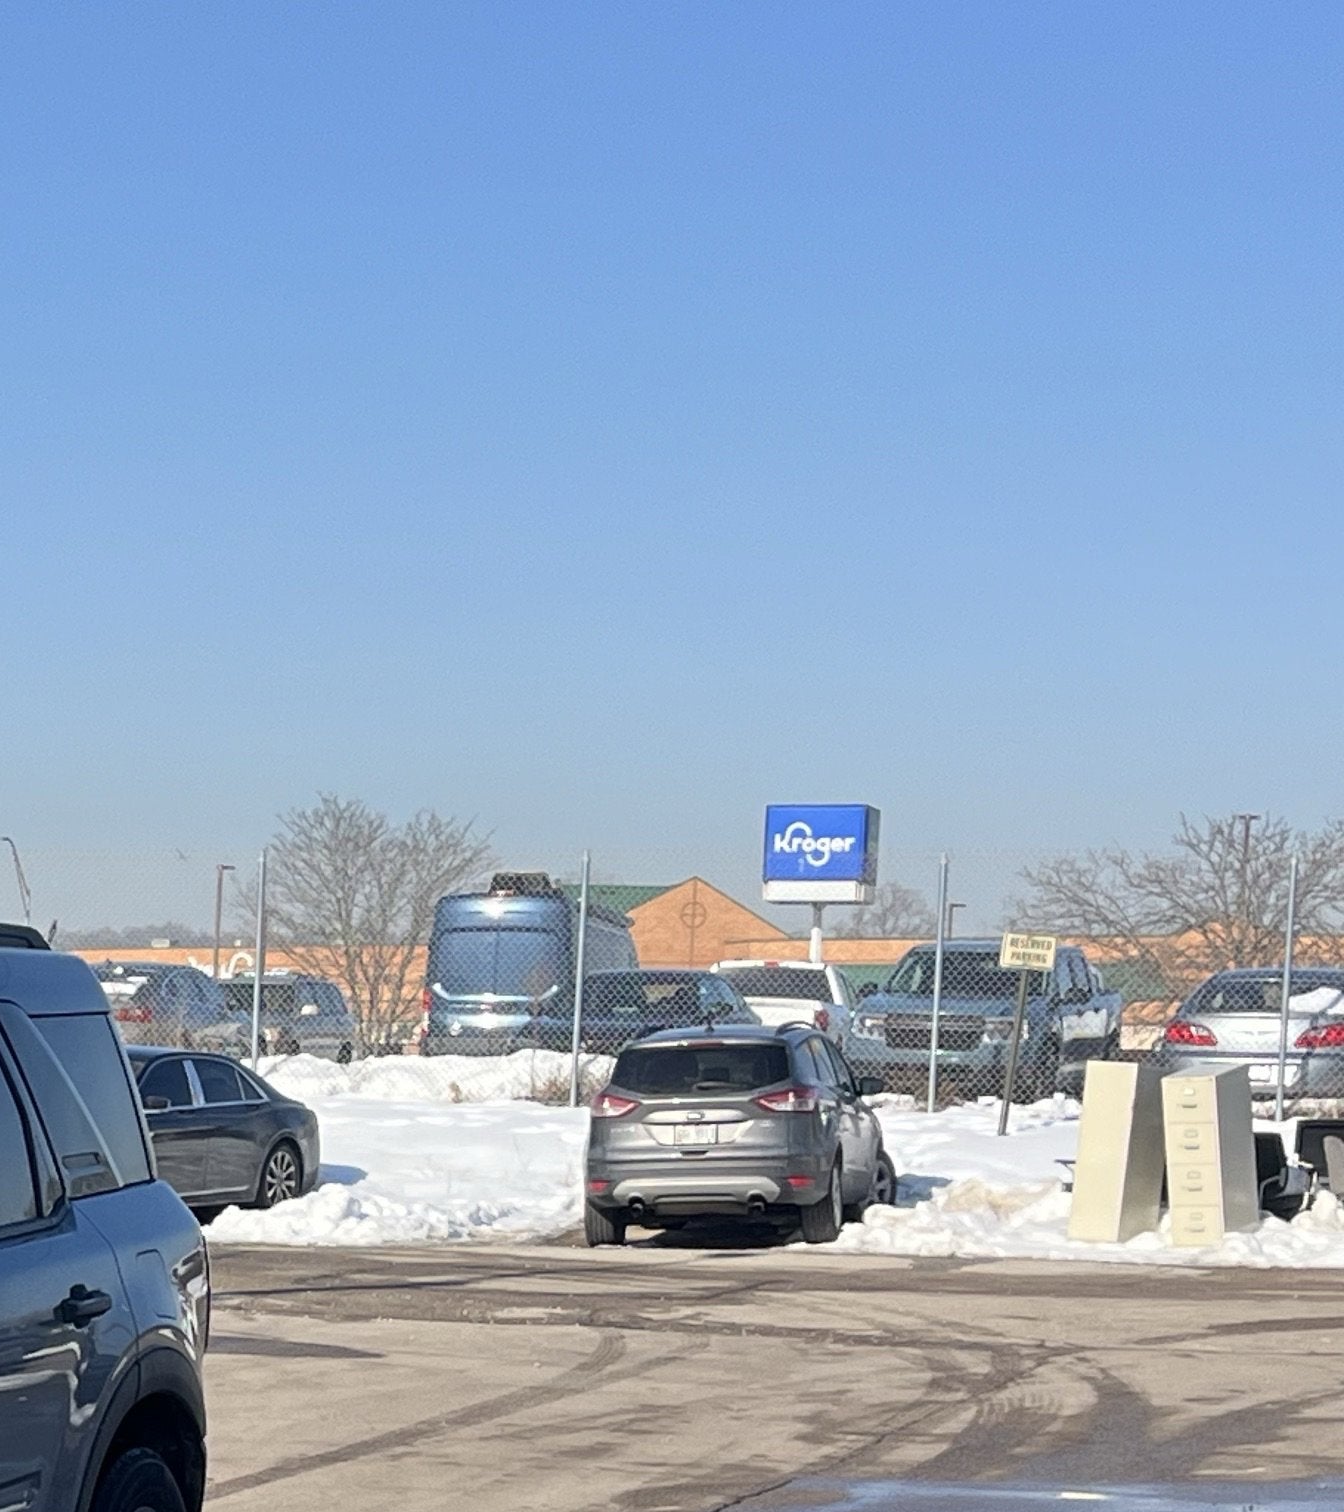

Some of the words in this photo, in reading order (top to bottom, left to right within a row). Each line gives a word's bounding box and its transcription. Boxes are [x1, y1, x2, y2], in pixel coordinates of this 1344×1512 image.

[773, 821, 856, 868] Kroger
[1010, 937, 1052, 951] RESERVED
[1011, 951, 1048, 964] PARKING
